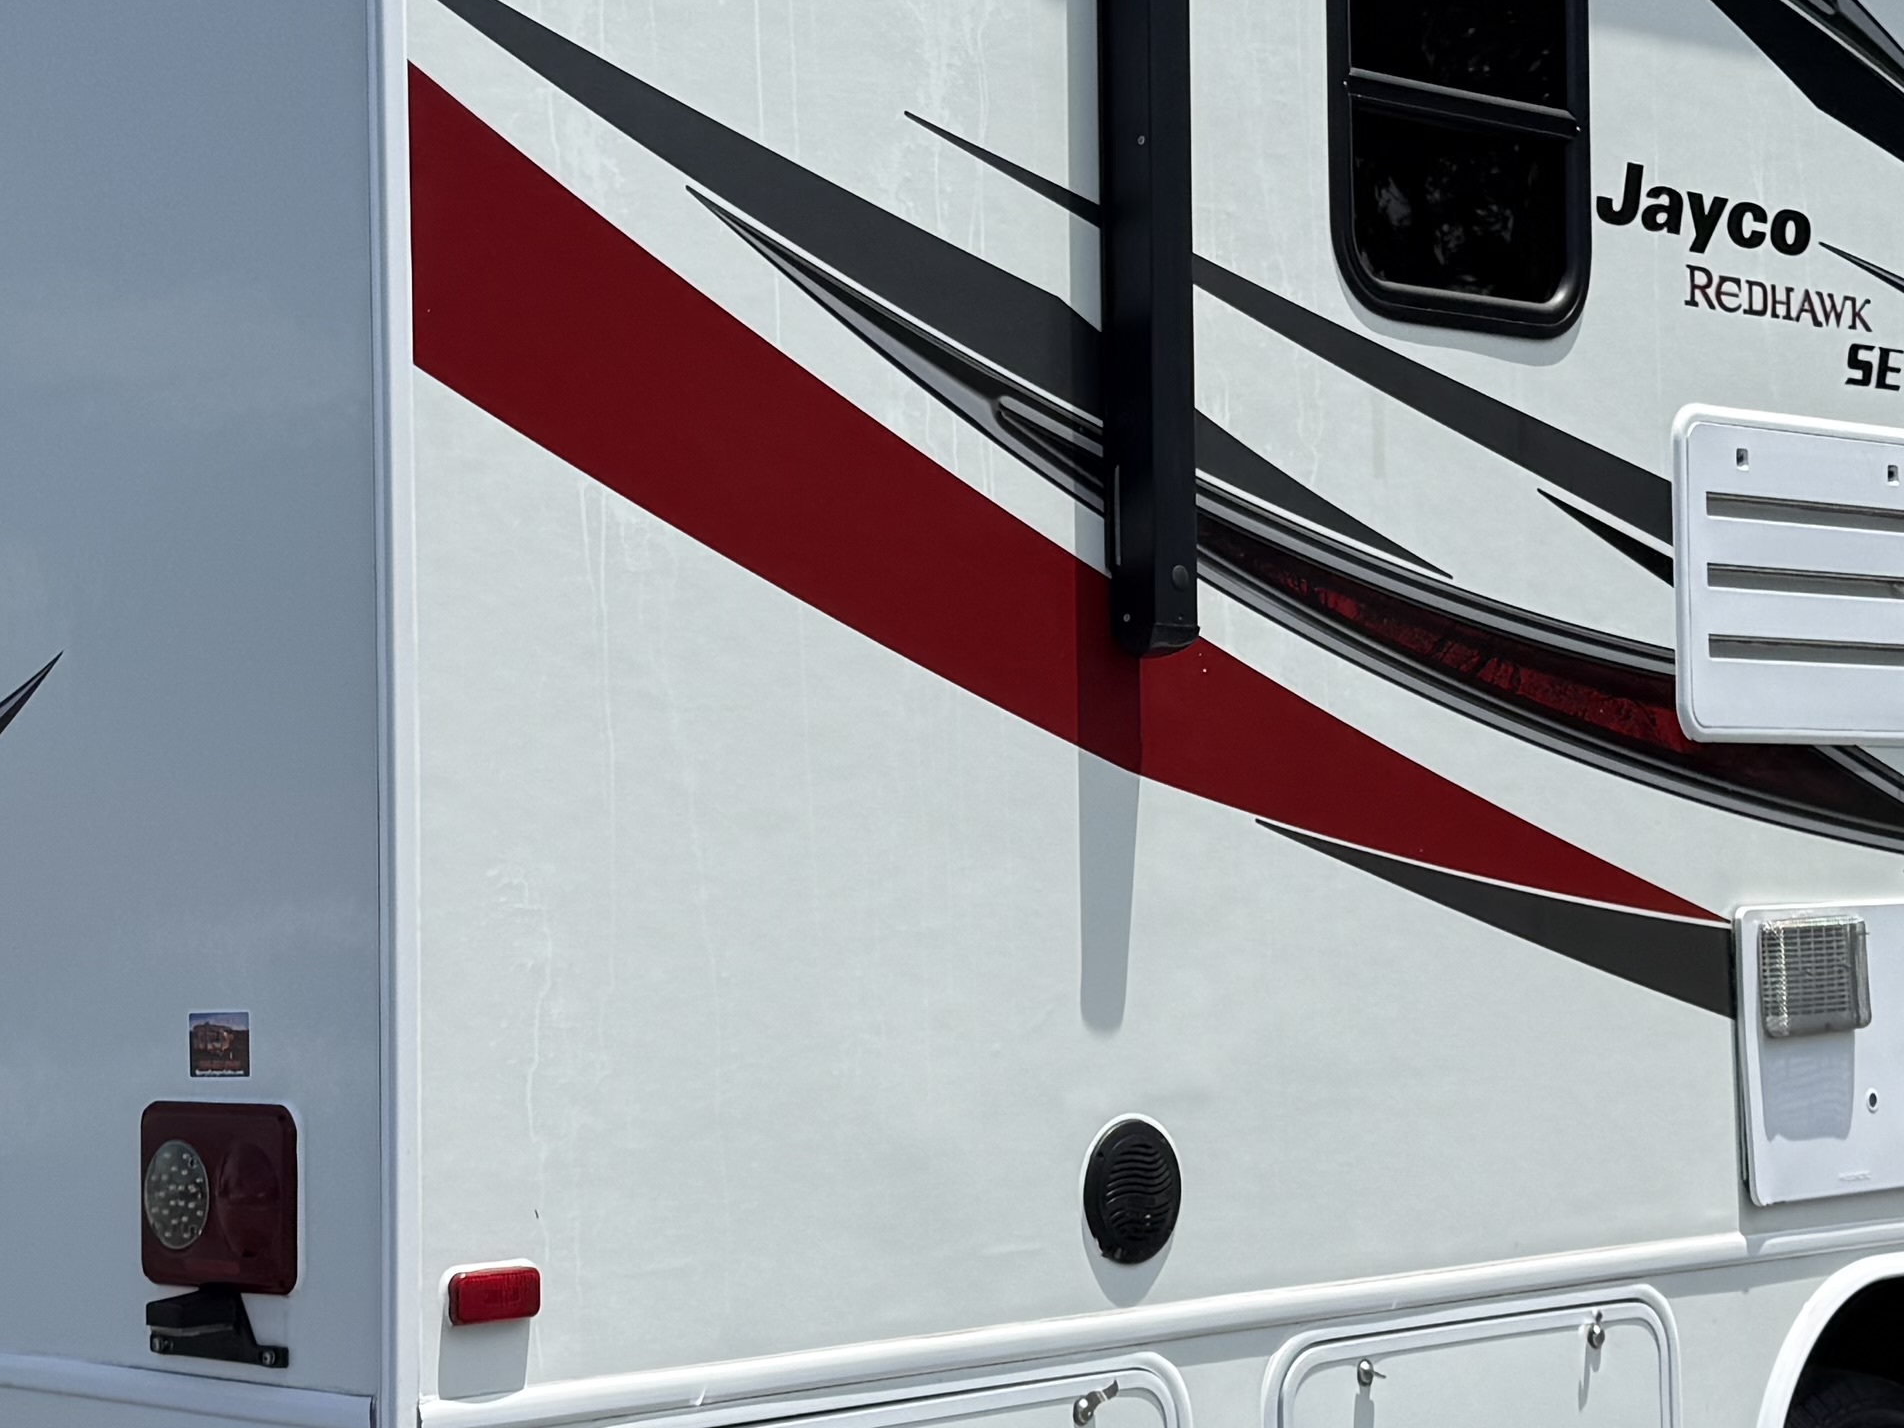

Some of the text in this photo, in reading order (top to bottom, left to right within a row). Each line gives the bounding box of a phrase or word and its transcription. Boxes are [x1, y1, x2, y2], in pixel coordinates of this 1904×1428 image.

[1596, 162, 1811, 256] Jayco
[1684, 263, 1873, 333] REDHAWK
[1844, 343, 1904, 392] SE
